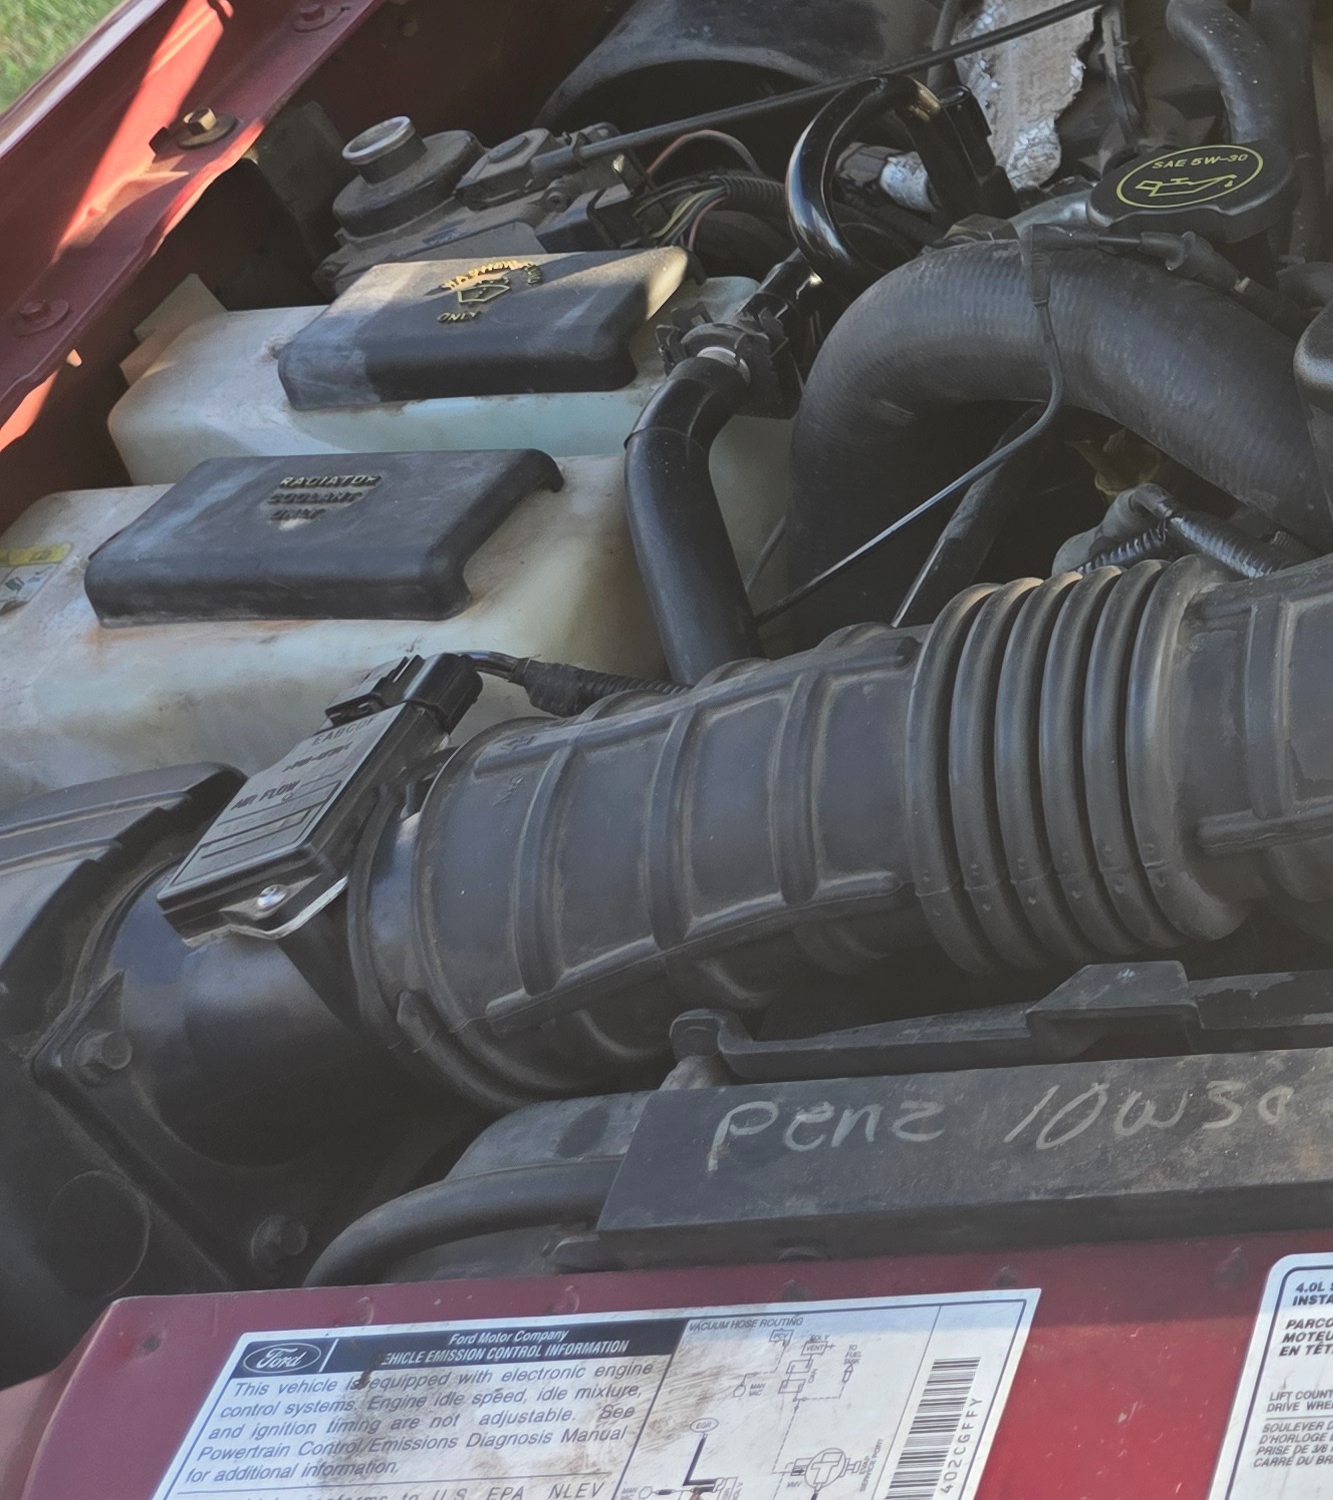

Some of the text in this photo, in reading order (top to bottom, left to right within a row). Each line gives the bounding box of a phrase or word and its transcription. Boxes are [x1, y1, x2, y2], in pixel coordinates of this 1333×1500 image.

[1152, 153, 1248, 169] SAE 5W-30
[279, 474, 382, 488] RADIATOR
[259, 779, 300, 802] FLOW
[1295, 1281, 1325, 1293] 4.0L
[688, 1316, 804, 1332] VACUUM HOSE ROUTING
[448, 1329, 569, 1346] Ford Motor Company
[257, 1347, 306, 1369] Ford
[381, 1340, 630, 1366] EHICLE EMISSION CONTROL INFORMATION
[1279, 1345, 1300, 1357] EN
[233, 1381, 269, 1397] This
[278, 1379, 337, 1395] vehicle
[369, 1370, 449, 1393] equipped
[458, 1368, 493, 1385] with
[501, 1365, 586, 1382] electronic
[594, 1362, 653, 1381] engine
[220, 1383, 643, 1418] control systems. Engine idle speed, idle mixture,
[1270, 1390, 1293, 1402] LIFT
[208, 1423, 242, 1440] and
[252, 1421, 317, 1441] ignition
[327, 1417, 381, 1437] timing
[391, 1417, 420, 1430] are
[430, 1414, 461, 1428] not
[599, 1405, 635, 1420] See
[196, 1426, 628, 1462] Powertrain Control/Emissions Diagnosis Manual
[184, 1468, 212, 1486] for
[212, 1462, 298, 1484] additional
